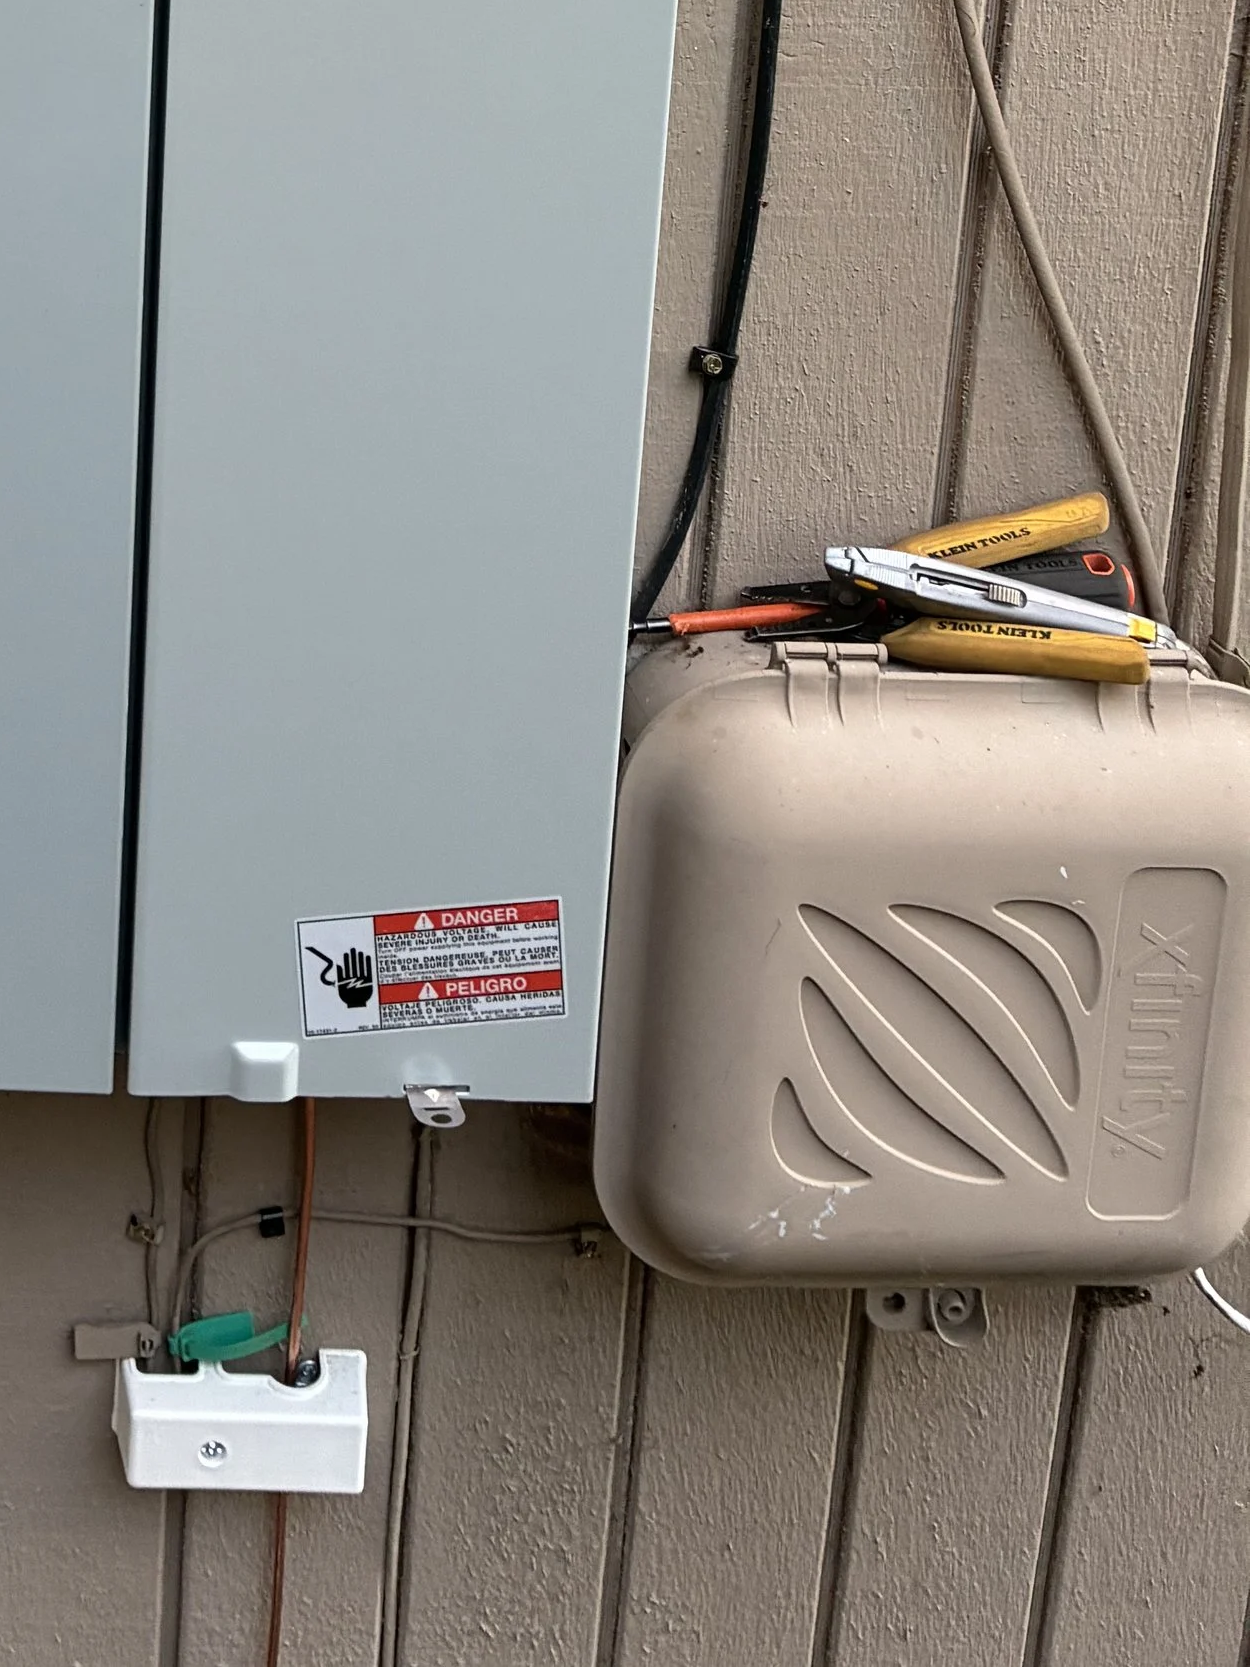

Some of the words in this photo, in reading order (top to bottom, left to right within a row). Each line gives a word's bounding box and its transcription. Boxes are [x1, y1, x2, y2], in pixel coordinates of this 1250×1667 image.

[927, 542, 977, 559] KLEIN
[977, 527, 1031, 548] TOOLS
[937, 620, 994, 634] TOOLS
[997, 626, 1052, 640] KLEIN
[441, 907, 519, 927] DANGER
[376, 931, 437, 942] HAZARDOUS
[495, 924, 518, 932] WILL
[524, 921, 557, 929] CAUSE
[377, 939, 412, 948] SEVERE
[415, 936, 448, 945] INJURY
[378, 957, 419, 966] TENSION
[519, 945, 558, 954] CAUSER
[378, 965, 397, 973] DES
[400, 961, 454, 971] BLESSURES
[456, 957, 495, 966] GRAVES
[497, 955, 512, 963] OU
[529, 951, 558, 960] MORT.
[445, 976, 527, 996] PELIGRO
[381, 1002, 421, 1011] VOLTAJE
[485, 994, 515, 1002] CAUSA
[520, 990, 560, 999] HERIDAS
[381, 1008, 423, 1017] SEVERAS
